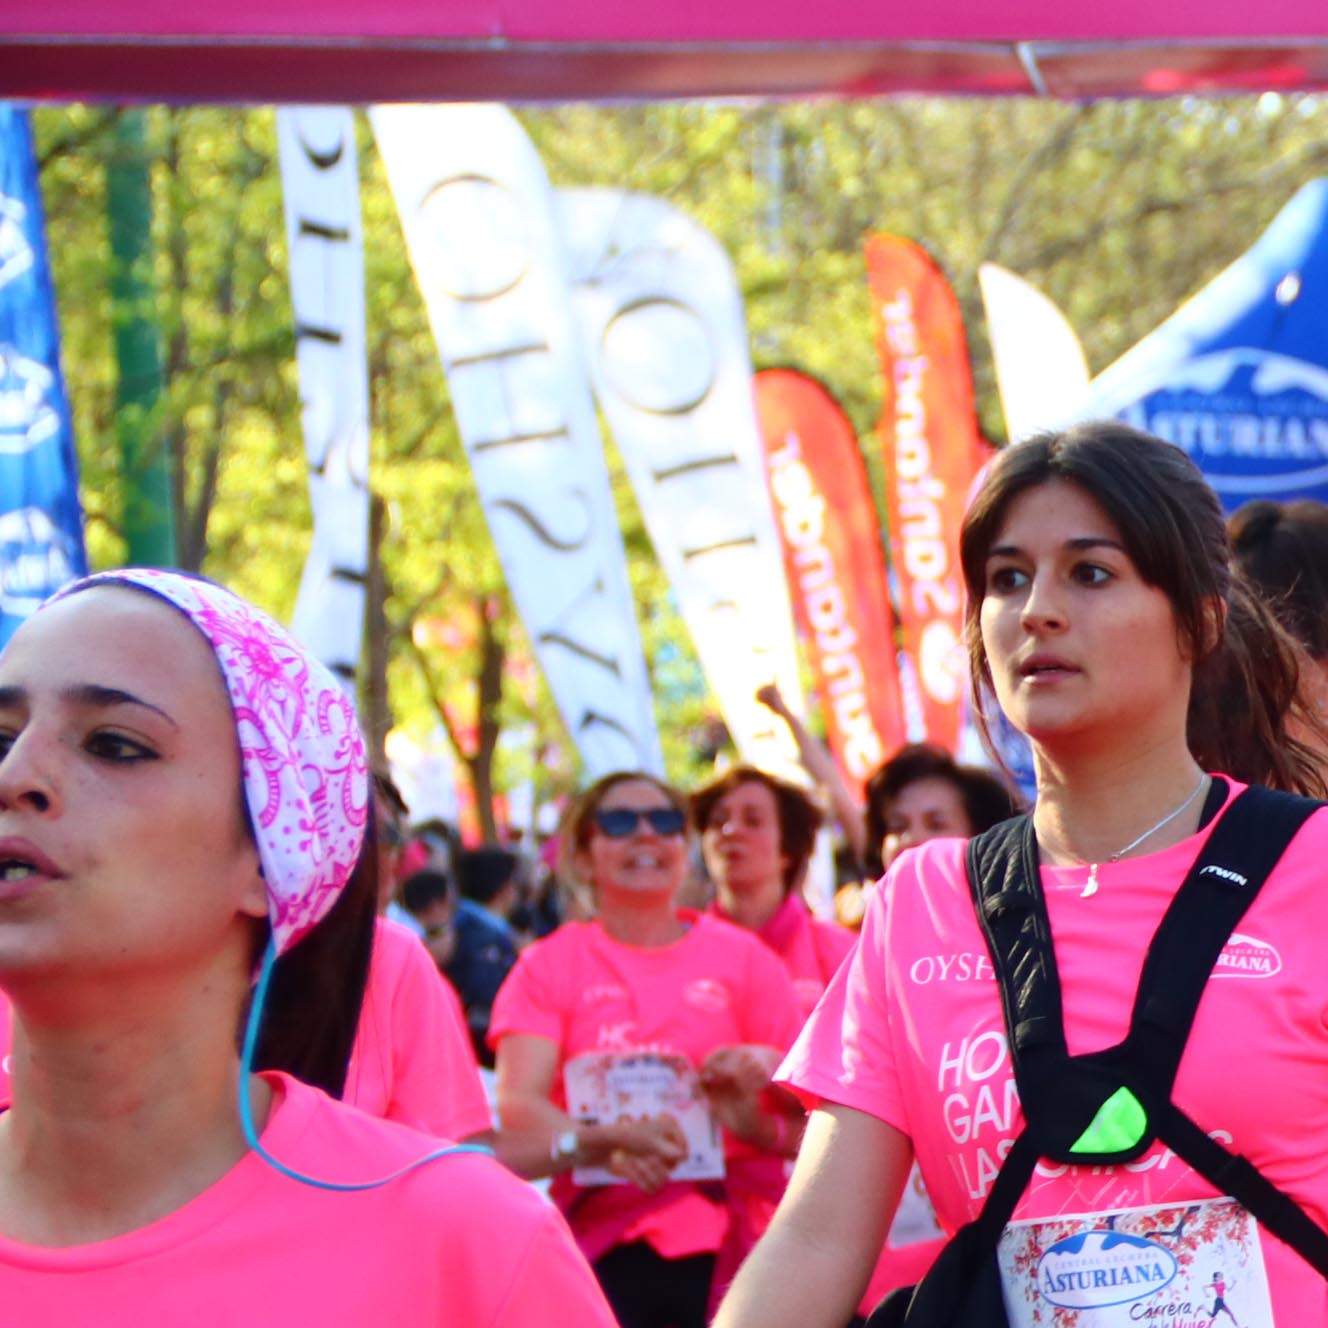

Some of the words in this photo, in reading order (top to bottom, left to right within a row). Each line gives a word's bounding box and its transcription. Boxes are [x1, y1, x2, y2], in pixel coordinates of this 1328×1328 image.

[937, 1031, 1012, 1092] HO
[1043, 1262, 1166, 1294] ASTURIANA
[1129, 1302, 1192, 1321] Carrera
